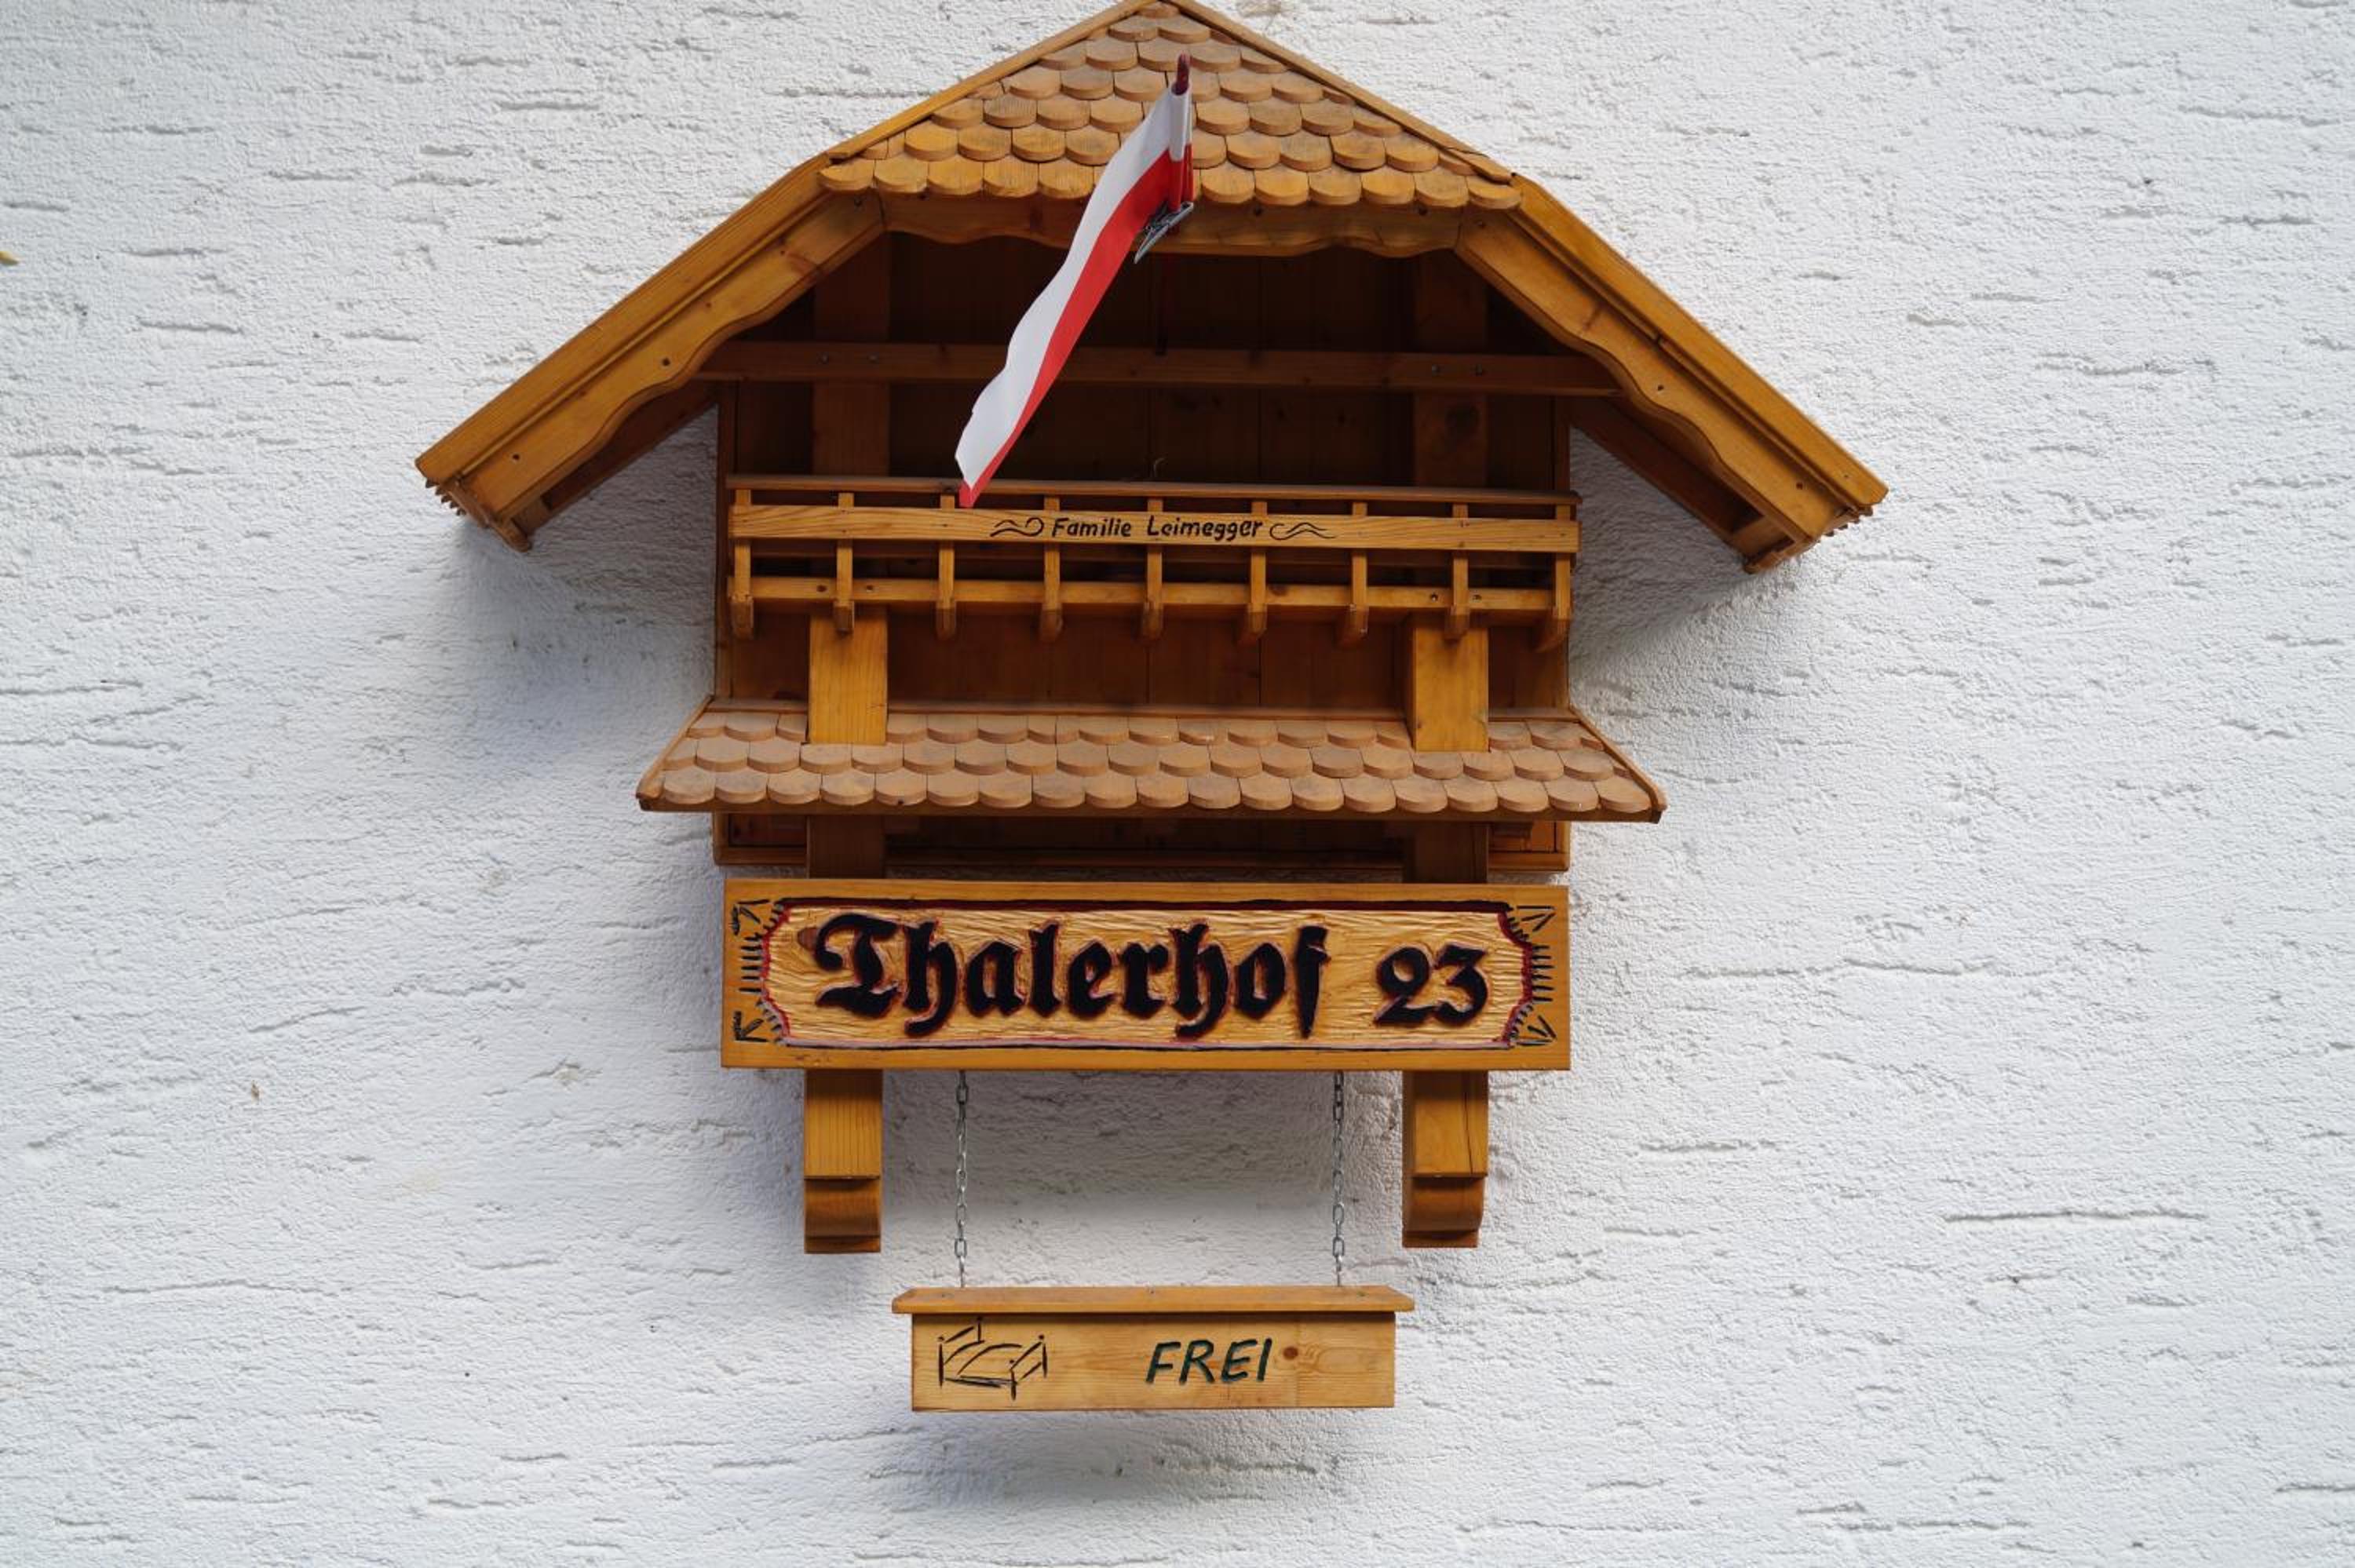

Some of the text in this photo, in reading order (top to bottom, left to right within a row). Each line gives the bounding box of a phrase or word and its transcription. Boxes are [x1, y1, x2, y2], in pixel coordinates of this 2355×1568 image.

[1052, 516, 1263, 541] Familie Leimegger
[815, 913, 1489, 1038] Thalerhof 23
[1145, 1338, 1273, 1384] FREI
